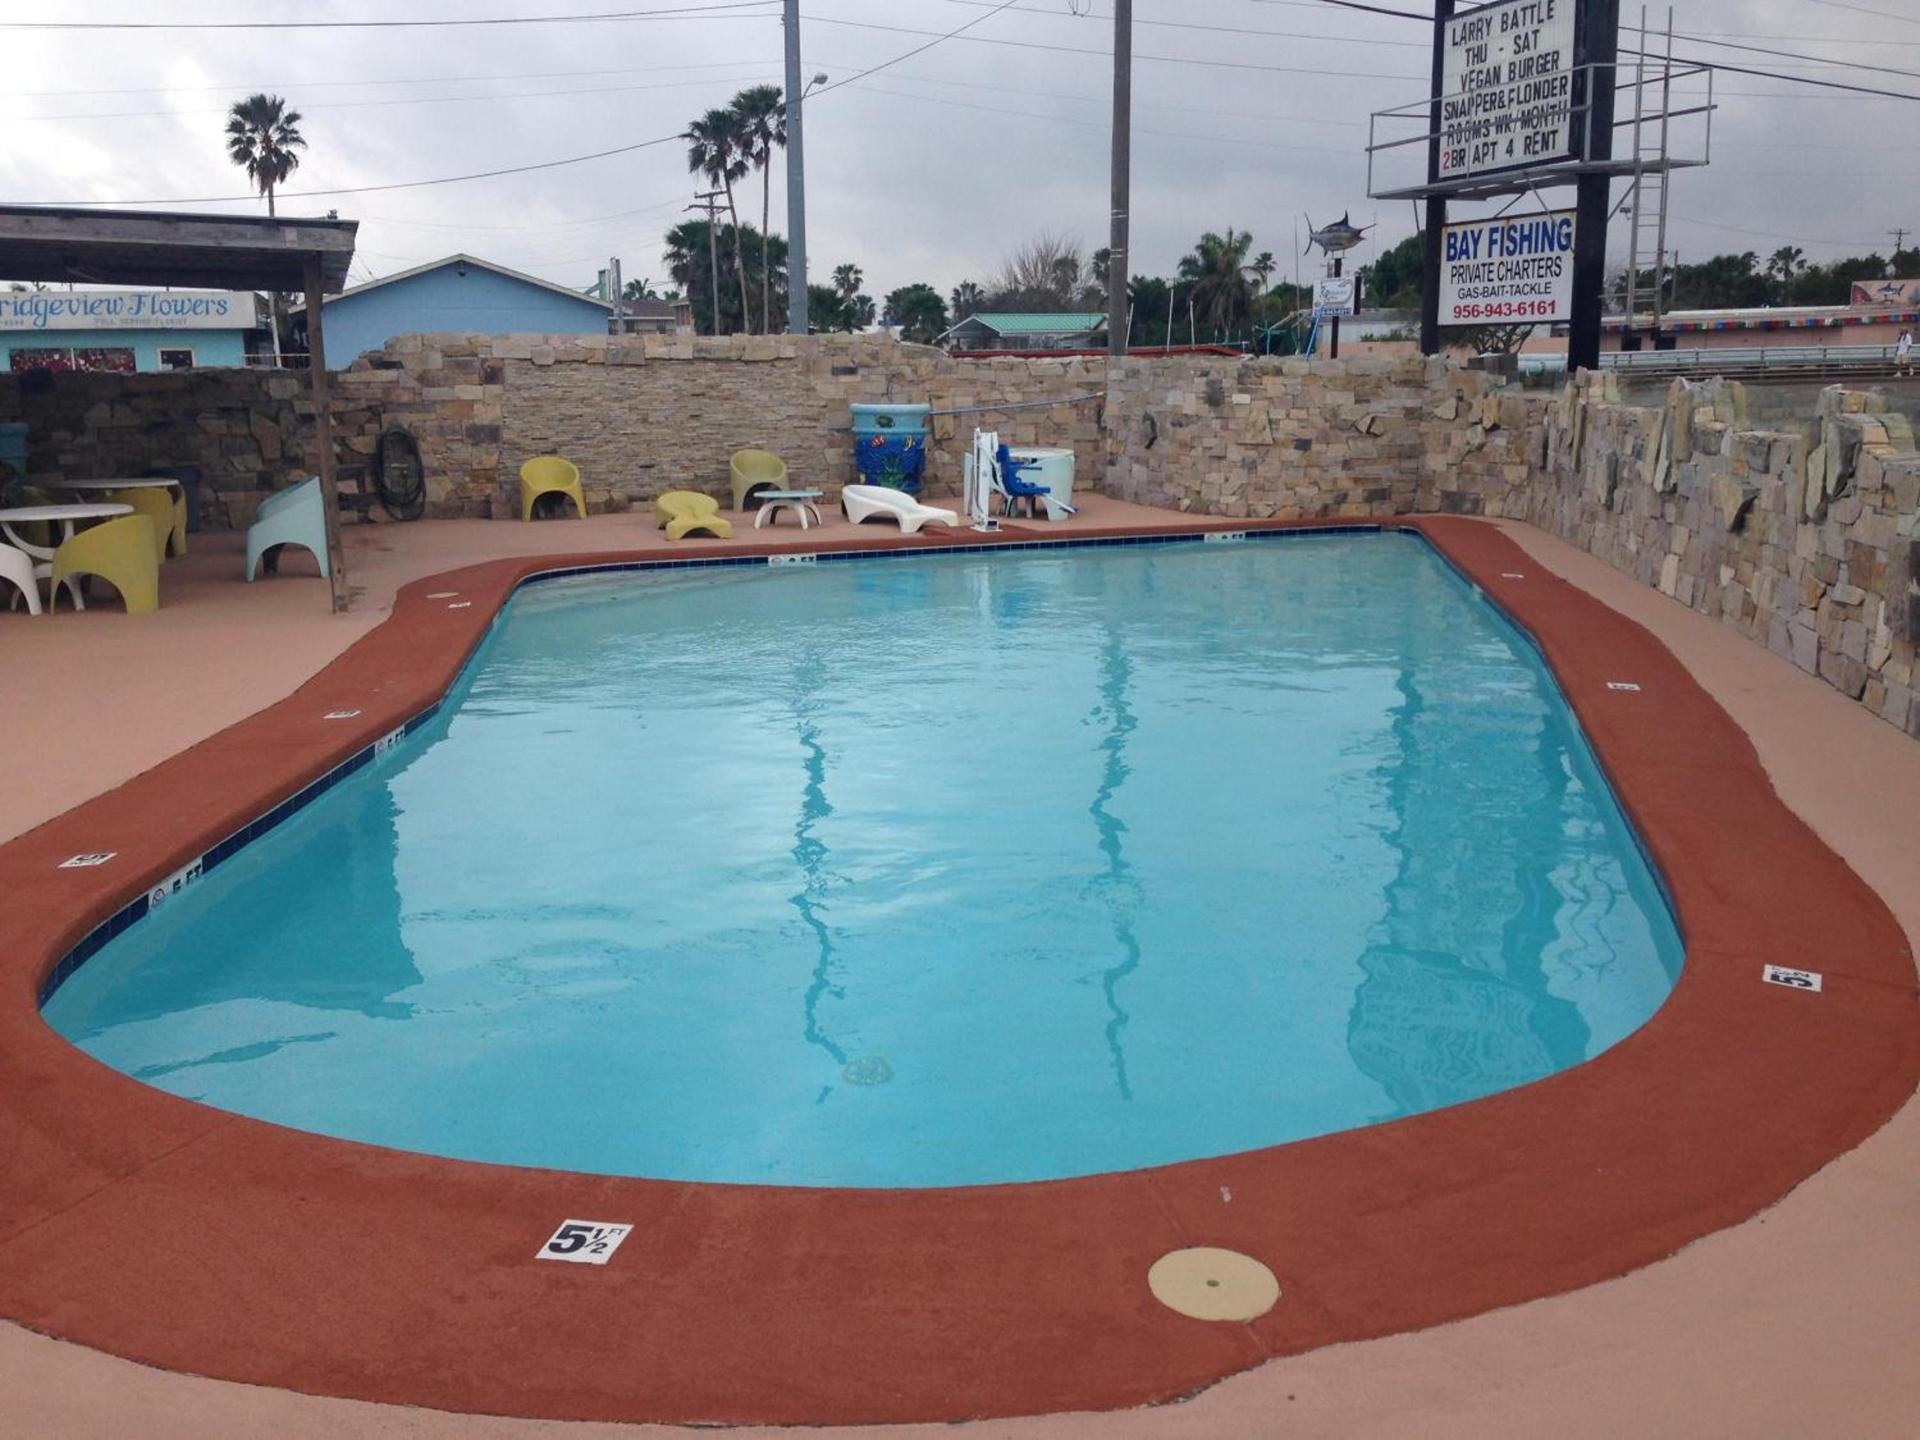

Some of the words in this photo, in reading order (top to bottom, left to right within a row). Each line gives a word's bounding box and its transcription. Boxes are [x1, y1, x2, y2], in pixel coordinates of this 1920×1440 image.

[1452, 16, 1493, 46] LARRY
[1501, 0, 1554, 33] BATTLE
[1465, 43, 1488, 67] THU
[1513, 29, 1540, 55] SAT
[1461, 65, 1502, 92] VEGAN
[1508, 50, 1560, 82] BURGER
[1446, 118, 1490, 146] ROOMS
[1495, 99, 1568, 135] WK/MONTH
[1442, 148, 1466, 172] 2BR
[1472, 140, 1498, 165] APT
[1505, 138, 1514, 158] 4
[1523, 129, 1559, 156] RENT
[1446, 228, 1483, 262] BAY
[1488, 217, 1572, 259] FISHING
[1450, 262, 1495, 285] PRIVATE
[1497, 256, 1562, 282] CHARTERS
[128, 294, 229, 316] Flowers
[1453, 300, 1556, 318] 956-943-6161
[1457, 282, 1552, 300] GAS-BAIT-TACKLE
